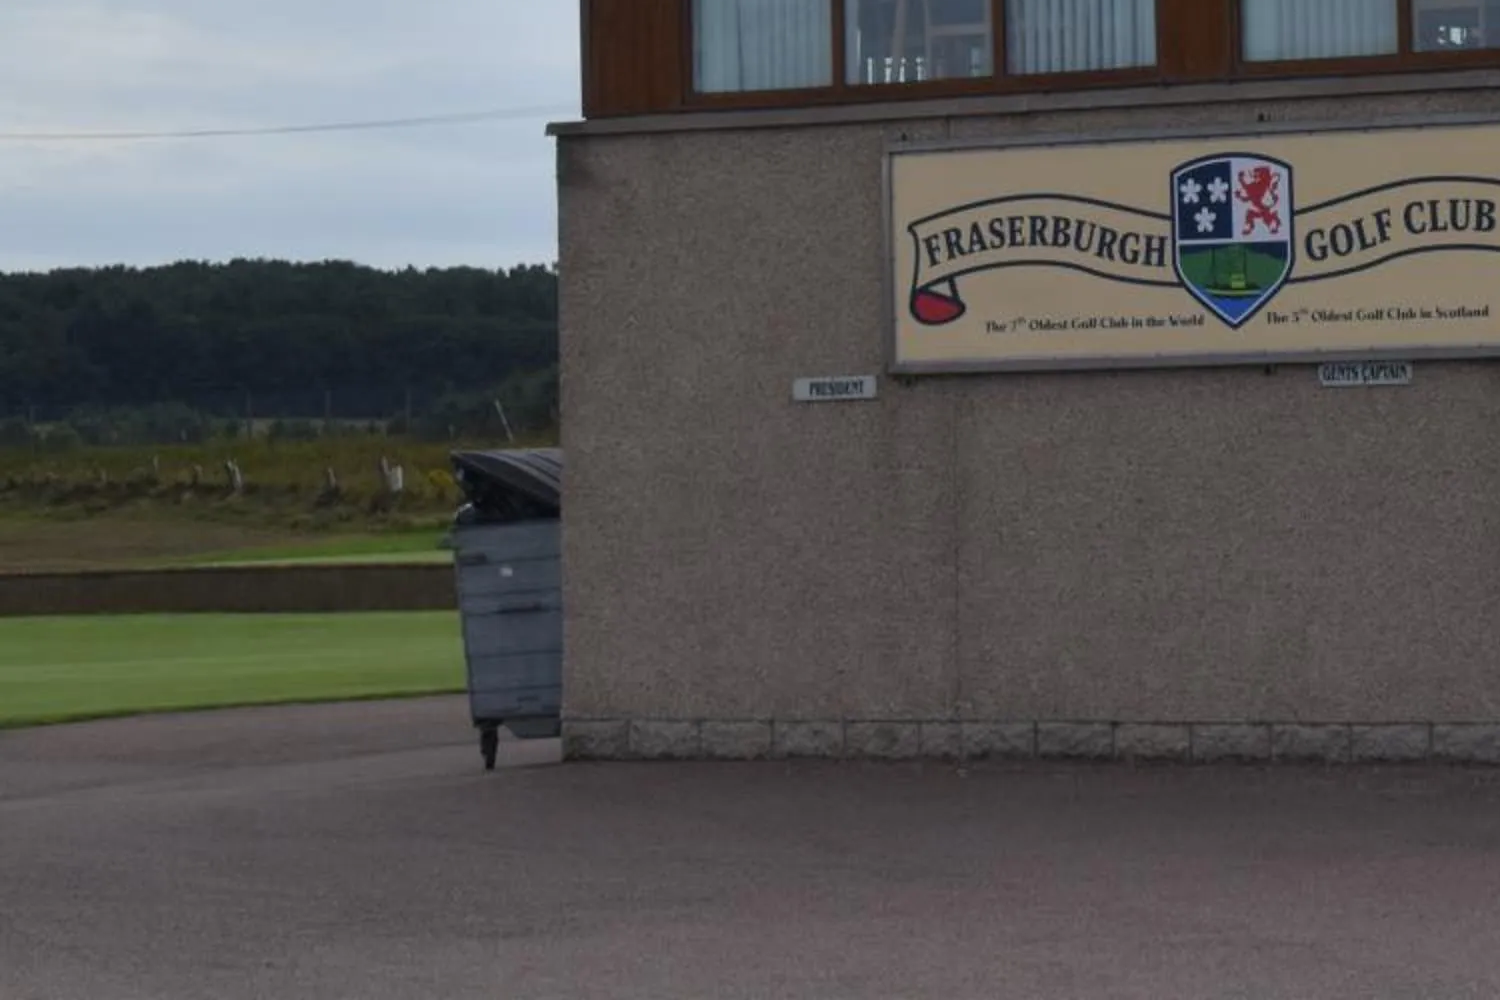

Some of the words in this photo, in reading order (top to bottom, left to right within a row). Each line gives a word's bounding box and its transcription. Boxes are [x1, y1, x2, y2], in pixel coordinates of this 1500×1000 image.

[922, 215, 1169, 268] FRASERBURGH
[1304, 208, 1392, 261] GOLF
[1403, 199, 1496, 235] CLUB
[986, 319, 1007, 333] The
[1029, 318, 1067, 332] Oldest
[1071, 317, 1098, 331] Golf
[1100, 316, 1128, 329] Club
[1131, 316, 1143, 328] in
[1146, 315, 1165, 327] the
[1168, 314, 1204, 327] World
[1267, 310, 1288, 325] The
[1311, 308, 1352, 323] Oldest
[1356, 307, 1384, 322] Golf
[1387, 307, 1416, 321] Club
[1419, 306, 1432, 319] in
[1435, 304, 1489, 319] Scotland
